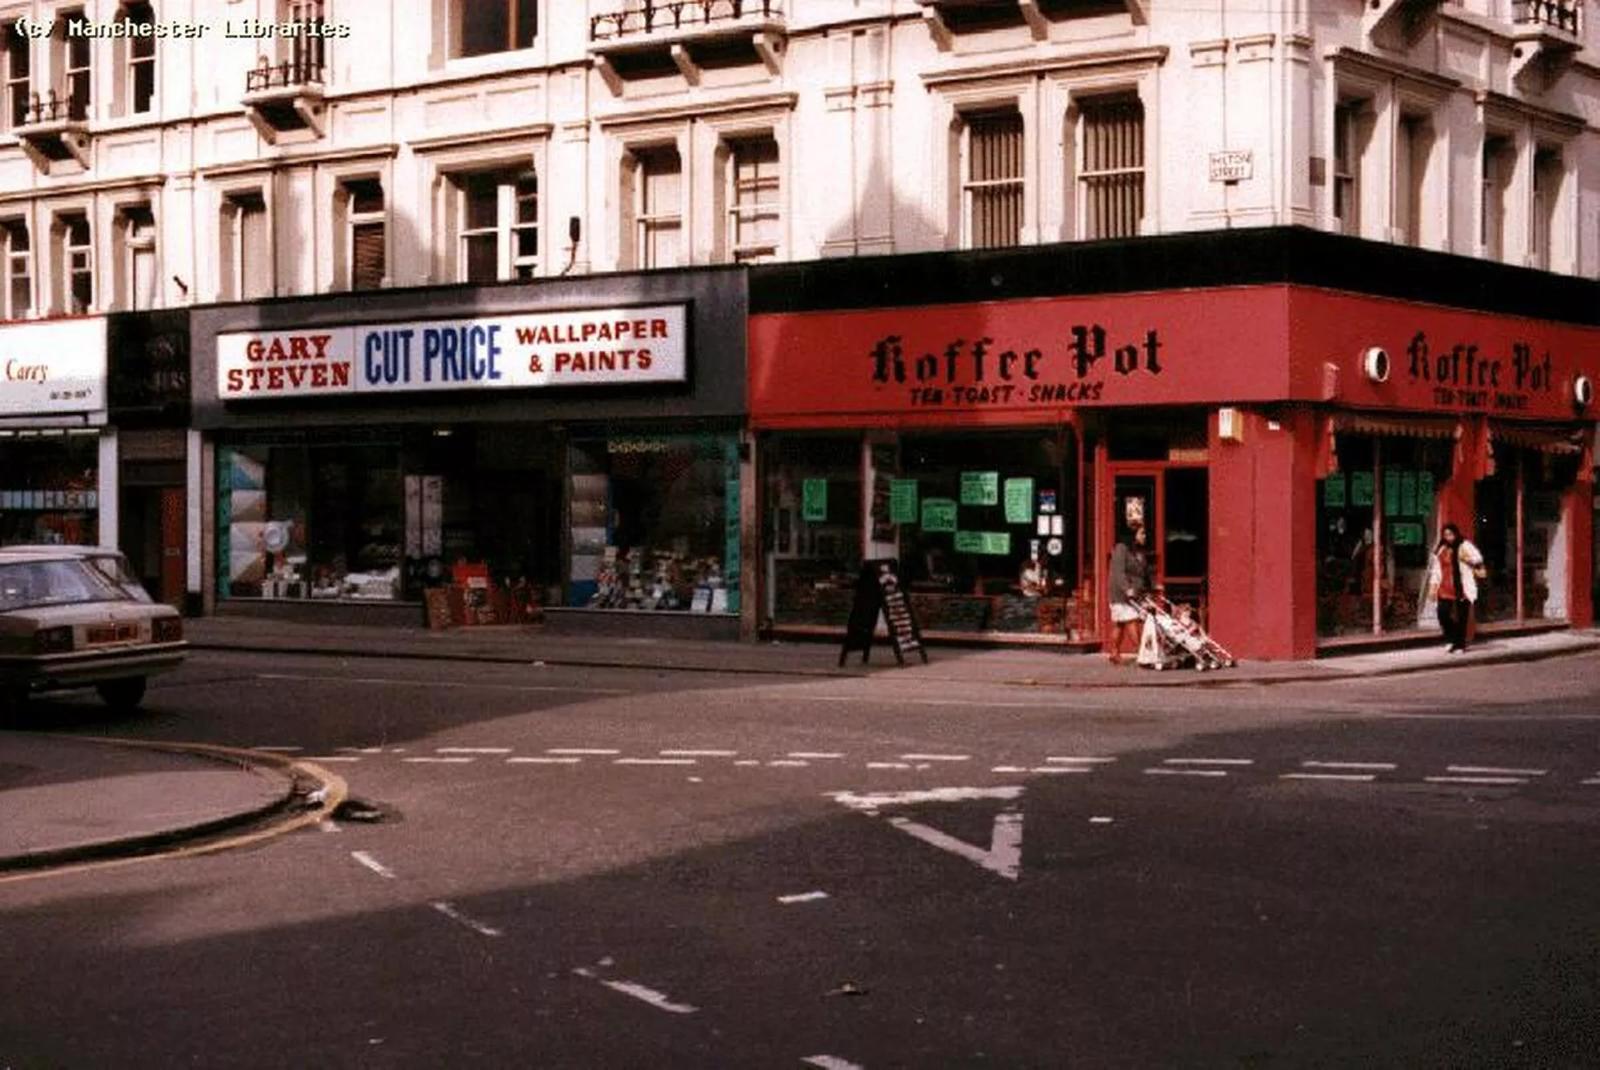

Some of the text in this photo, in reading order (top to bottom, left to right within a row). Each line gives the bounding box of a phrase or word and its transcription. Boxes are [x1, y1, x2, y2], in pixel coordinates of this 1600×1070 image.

[515, 319, 668, 345] WALLPAPER
[246, 335, 332, 362] GARY
[365, 324, 502, 385] CUT PRICE
[528, 349, 652, 373] & PAINTS
[870, 324, 1162, 383] Koffee Pot
[1407, 330, 1552, 392] Koffee Pot
[6, 358, 48, 384] Carry
[227, 362, 351, 391] STEVEN
[1028, 381, 1104, 401] SNACKS
